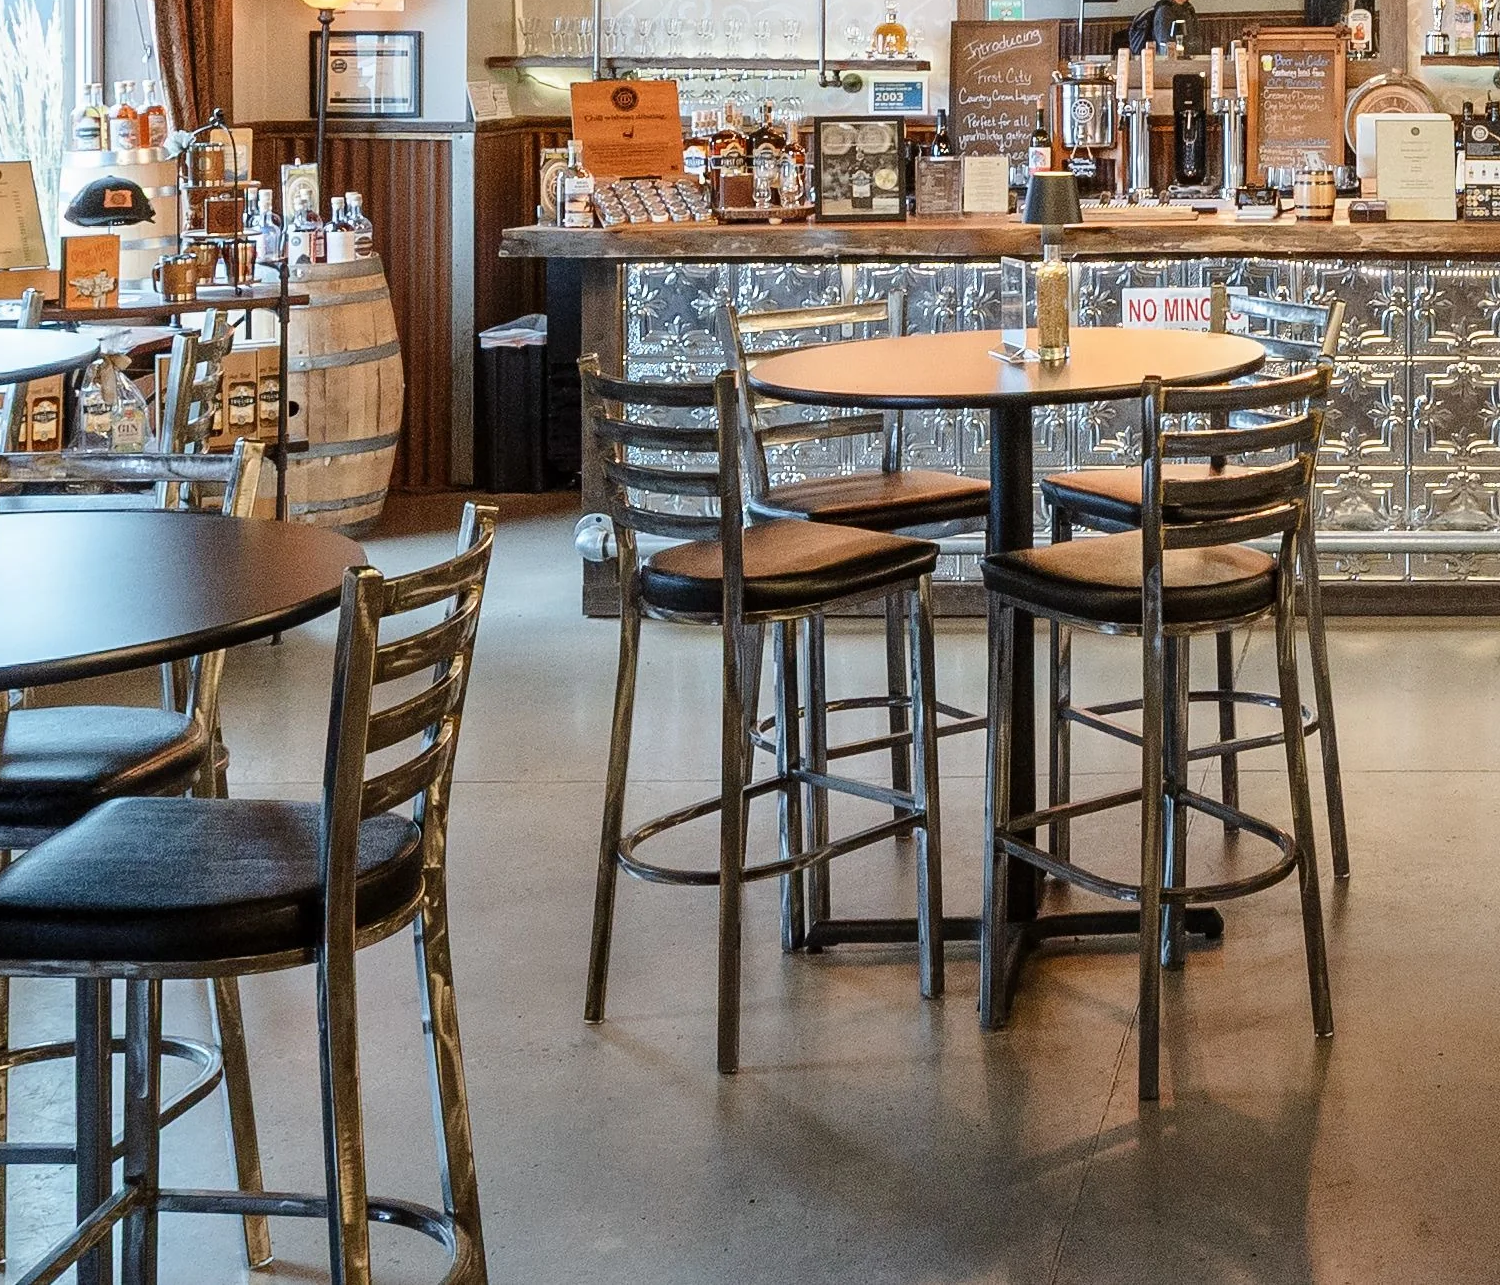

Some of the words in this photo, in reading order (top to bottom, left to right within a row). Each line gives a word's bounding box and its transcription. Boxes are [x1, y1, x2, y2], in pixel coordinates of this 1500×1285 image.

[963, 29, 1042, 60] Introducing
[973, 65, 1004, 85] First
[1005, 67, 1032, 86] City
[875, 92, 904, 102] 2003
[963, 113, 997, 130] Perfect
[998, 112, 1011, 130] for
[1013, 118, 1030, 127] all
[1129, 298, 1158, 322] NO
[117, 423, 138, 434] GIN
